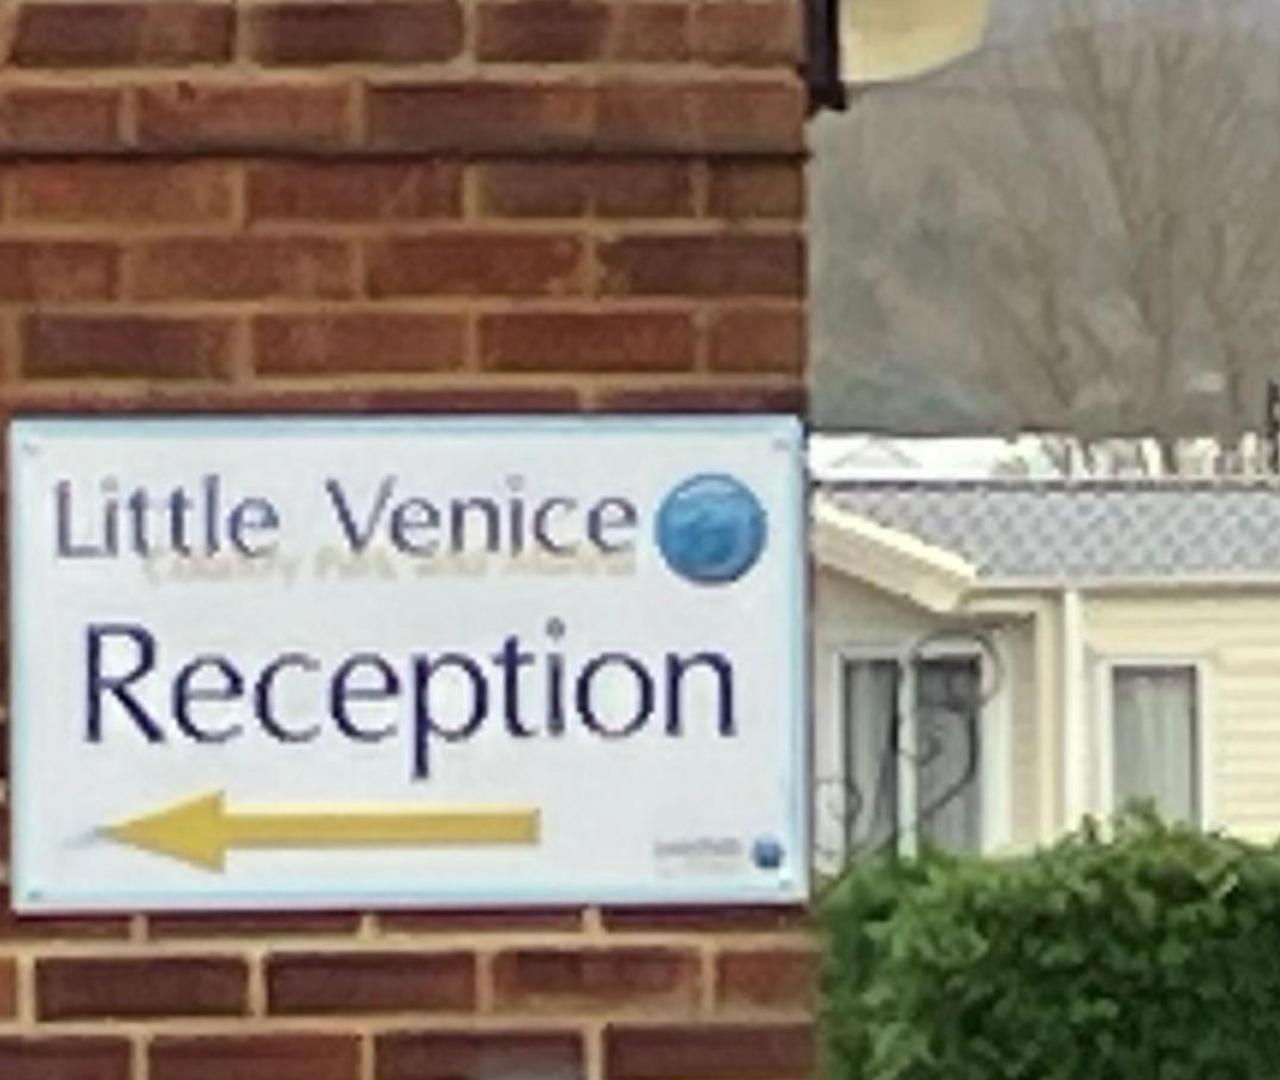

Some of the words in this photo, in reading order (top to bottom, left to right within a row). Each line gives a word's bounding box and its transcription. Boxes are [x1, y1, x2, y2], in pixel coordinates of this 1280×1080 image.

[54, 474, 280, 558] Little
[326, 474, 640, 558] Venice
[84, 618, 738, 780] Reception
